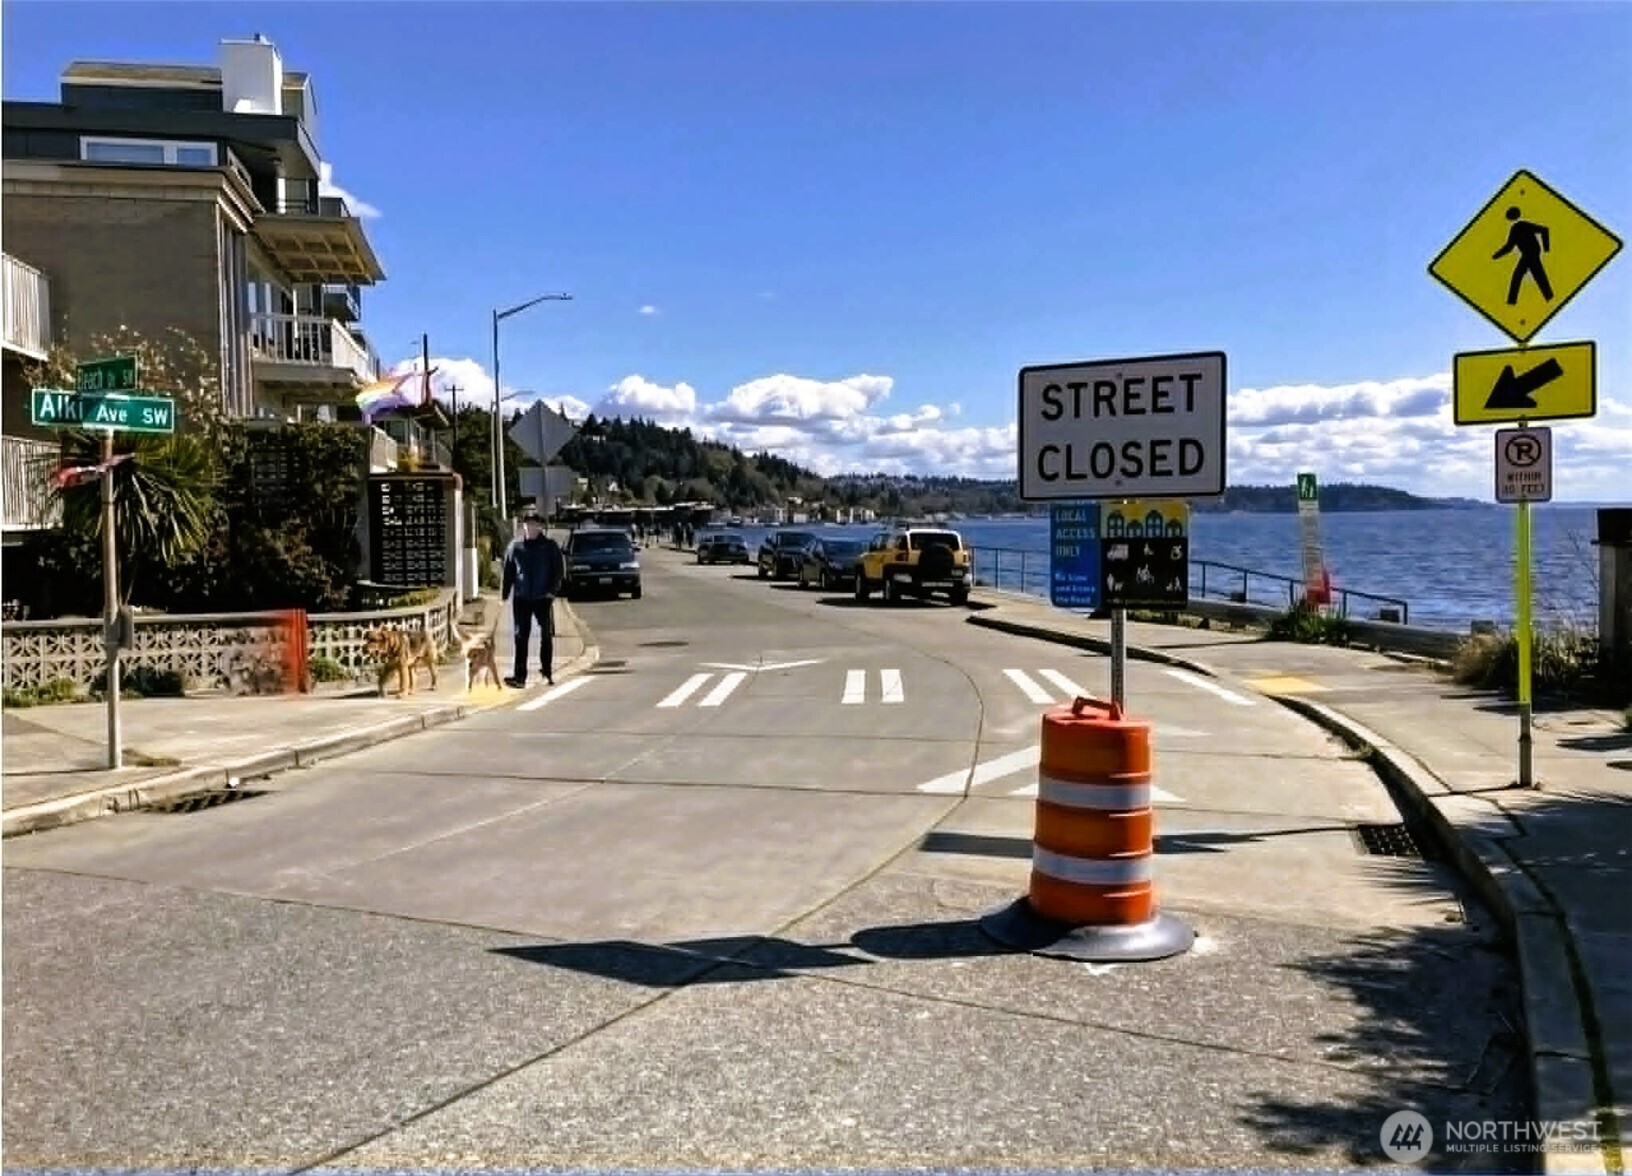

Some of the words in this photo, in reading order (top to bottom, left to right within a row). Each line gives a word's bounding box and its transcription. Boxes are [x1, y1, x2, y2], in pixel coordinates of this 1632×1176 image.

[1041, 373, 1203, 421] STREET
[39, 394, 83, 419] Alki
[96, 404, 128, 422] Ave
[142, 407, 168, 426] SW
[1038, 438, 1204, 482] CLOSED
[1521, 484, 1545, 494] FEET
[1056, 509, 1086, 522] LOCAL
[1056, 528, 1096, 539] ACCESS
[1056, 545, 1080, 557] ONLY
